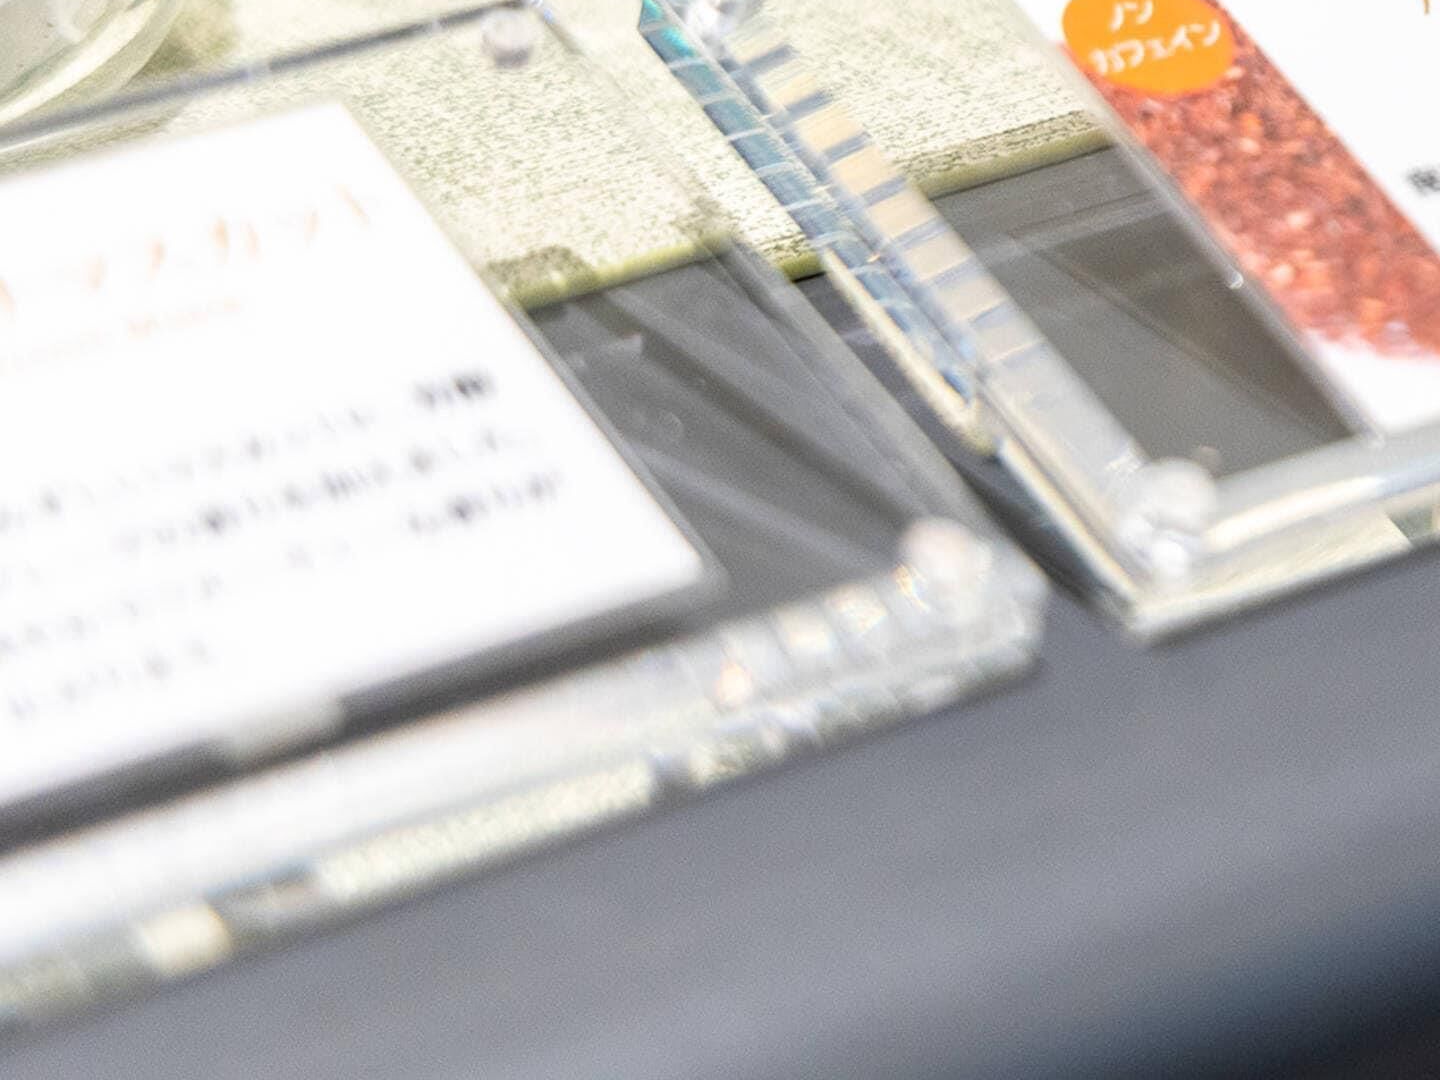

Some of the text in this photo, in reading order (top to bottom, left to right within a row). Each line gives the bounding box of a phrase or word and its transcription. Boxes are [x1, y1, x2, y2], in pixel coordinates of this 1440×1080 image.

[1089, 19, 1222, 77] カフェイン
